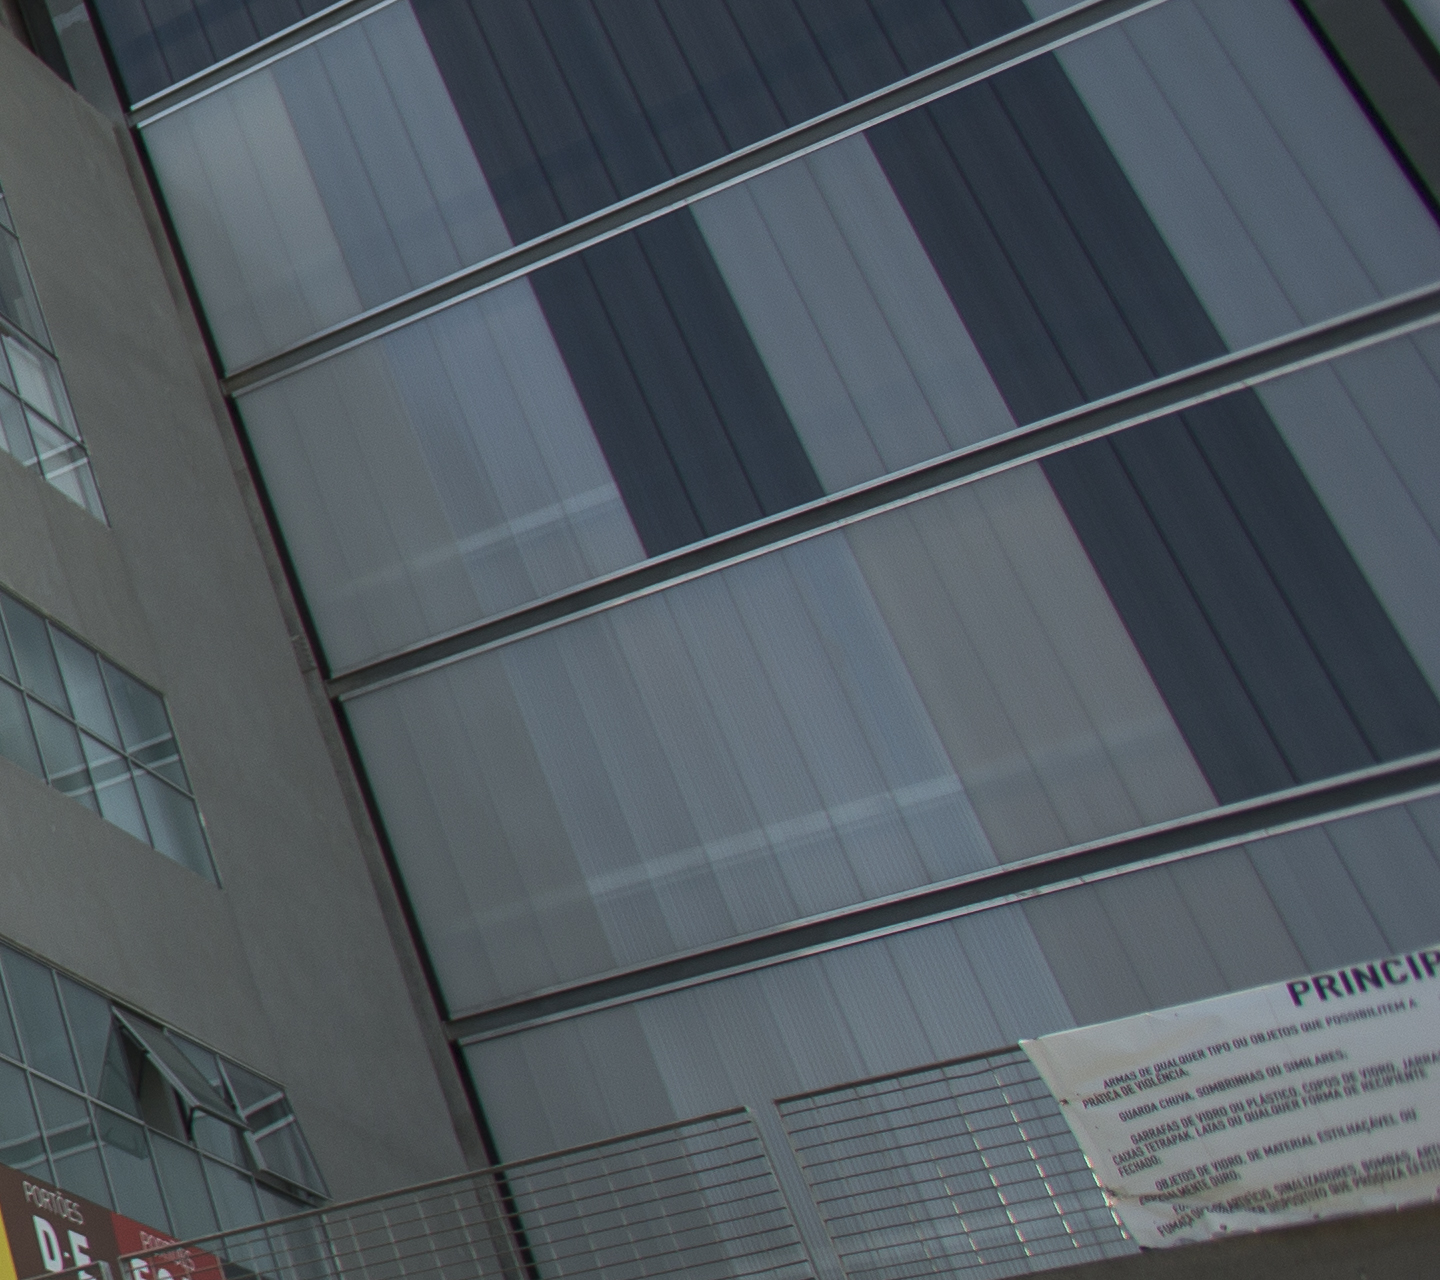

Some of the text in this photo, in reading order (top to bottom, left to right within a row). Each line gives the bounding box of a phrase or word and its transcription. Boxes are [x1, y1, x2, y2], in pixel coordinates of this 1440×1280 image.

[1103, 1071, 1137, 1090] ARMAS
[1138, 1066, 1151, 1078] DE
[1153, 1049, 1206, 1073] QUALQUER
[1207, 1040, 1230, 1056] TIPO
[1232, 1035, 1248, 1049] OU
[1249, 1024, 1299, 1045] OBJETOS
[1300, 1018, 1323, 1033] QUE
[1081, 1093, 1122, 1110] PRÁTICA
[1120, 1083, 1136, 1097] DE
[1118, 1102, 1159, 1123] GUARDA
[1195, 1070, 1265, 1099] SOMBRINHAS
[1265, 1064, 1282, 1078] OU
[1130, 1120, 1180, 1146] GARRAFAS
[1180, 1114, 1195, 1129] DE
[1194, 1105, 1228, 1124] VIDRO
[1228, 1099, 1245, 1114] OU
[1112, 1146, 1145, 1167] CAIXAS
[1226, 1113, 1243, 1128] OU
[1243, 1097, 1300, 1123] QUALQUER
[1300, 1088, 1342, 1108] FORMA
[1155, 1168, 1196, 1192] OBJETOS
[1196, 1164, 1211, 1178] DE
[1246, 1147, 1262, 1162] DE
[1262, 1133, 1316, 1157] MATERIAL
[23, 1181, 84, 1225] PORTÕES
